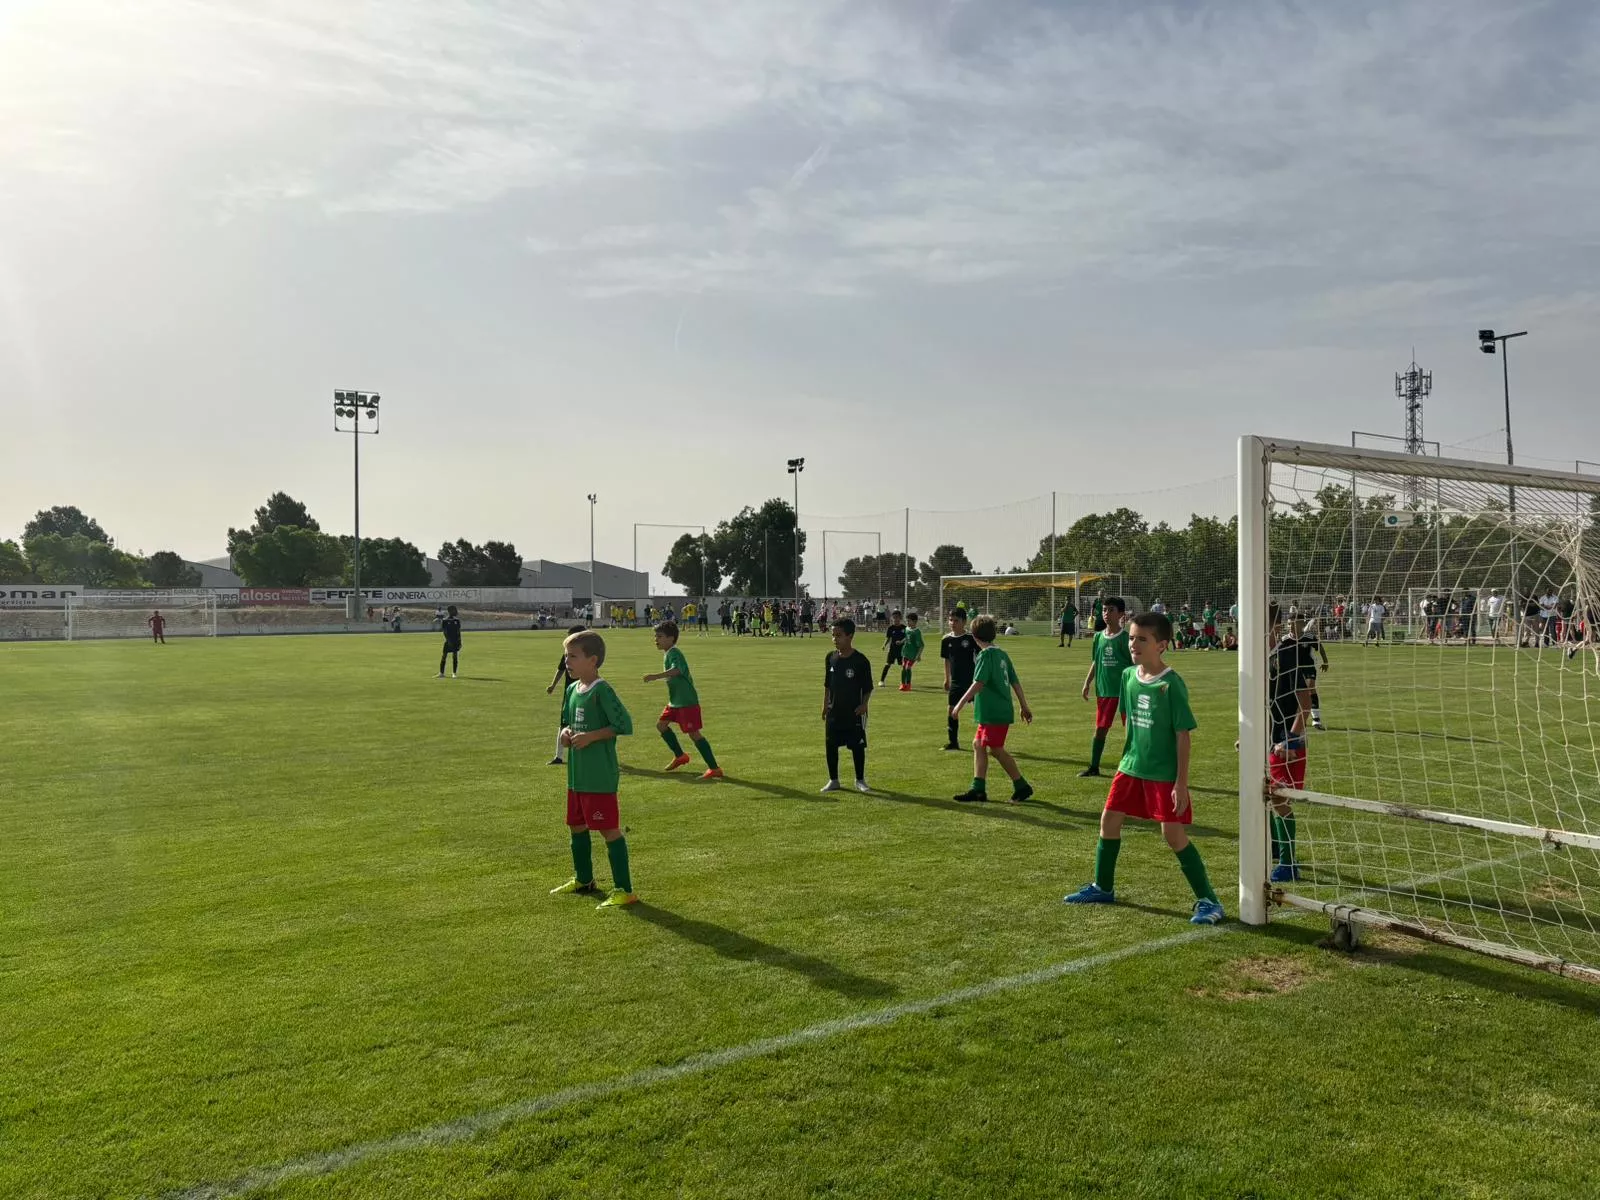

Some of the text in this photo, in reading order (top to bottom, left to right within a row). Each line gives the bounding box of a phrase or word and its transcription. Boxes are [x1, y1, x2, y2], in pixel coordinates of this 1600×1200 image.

[241, 589, 280, 601] alosa
[387, 590, 478, 600] ONNERA CONTRACT
